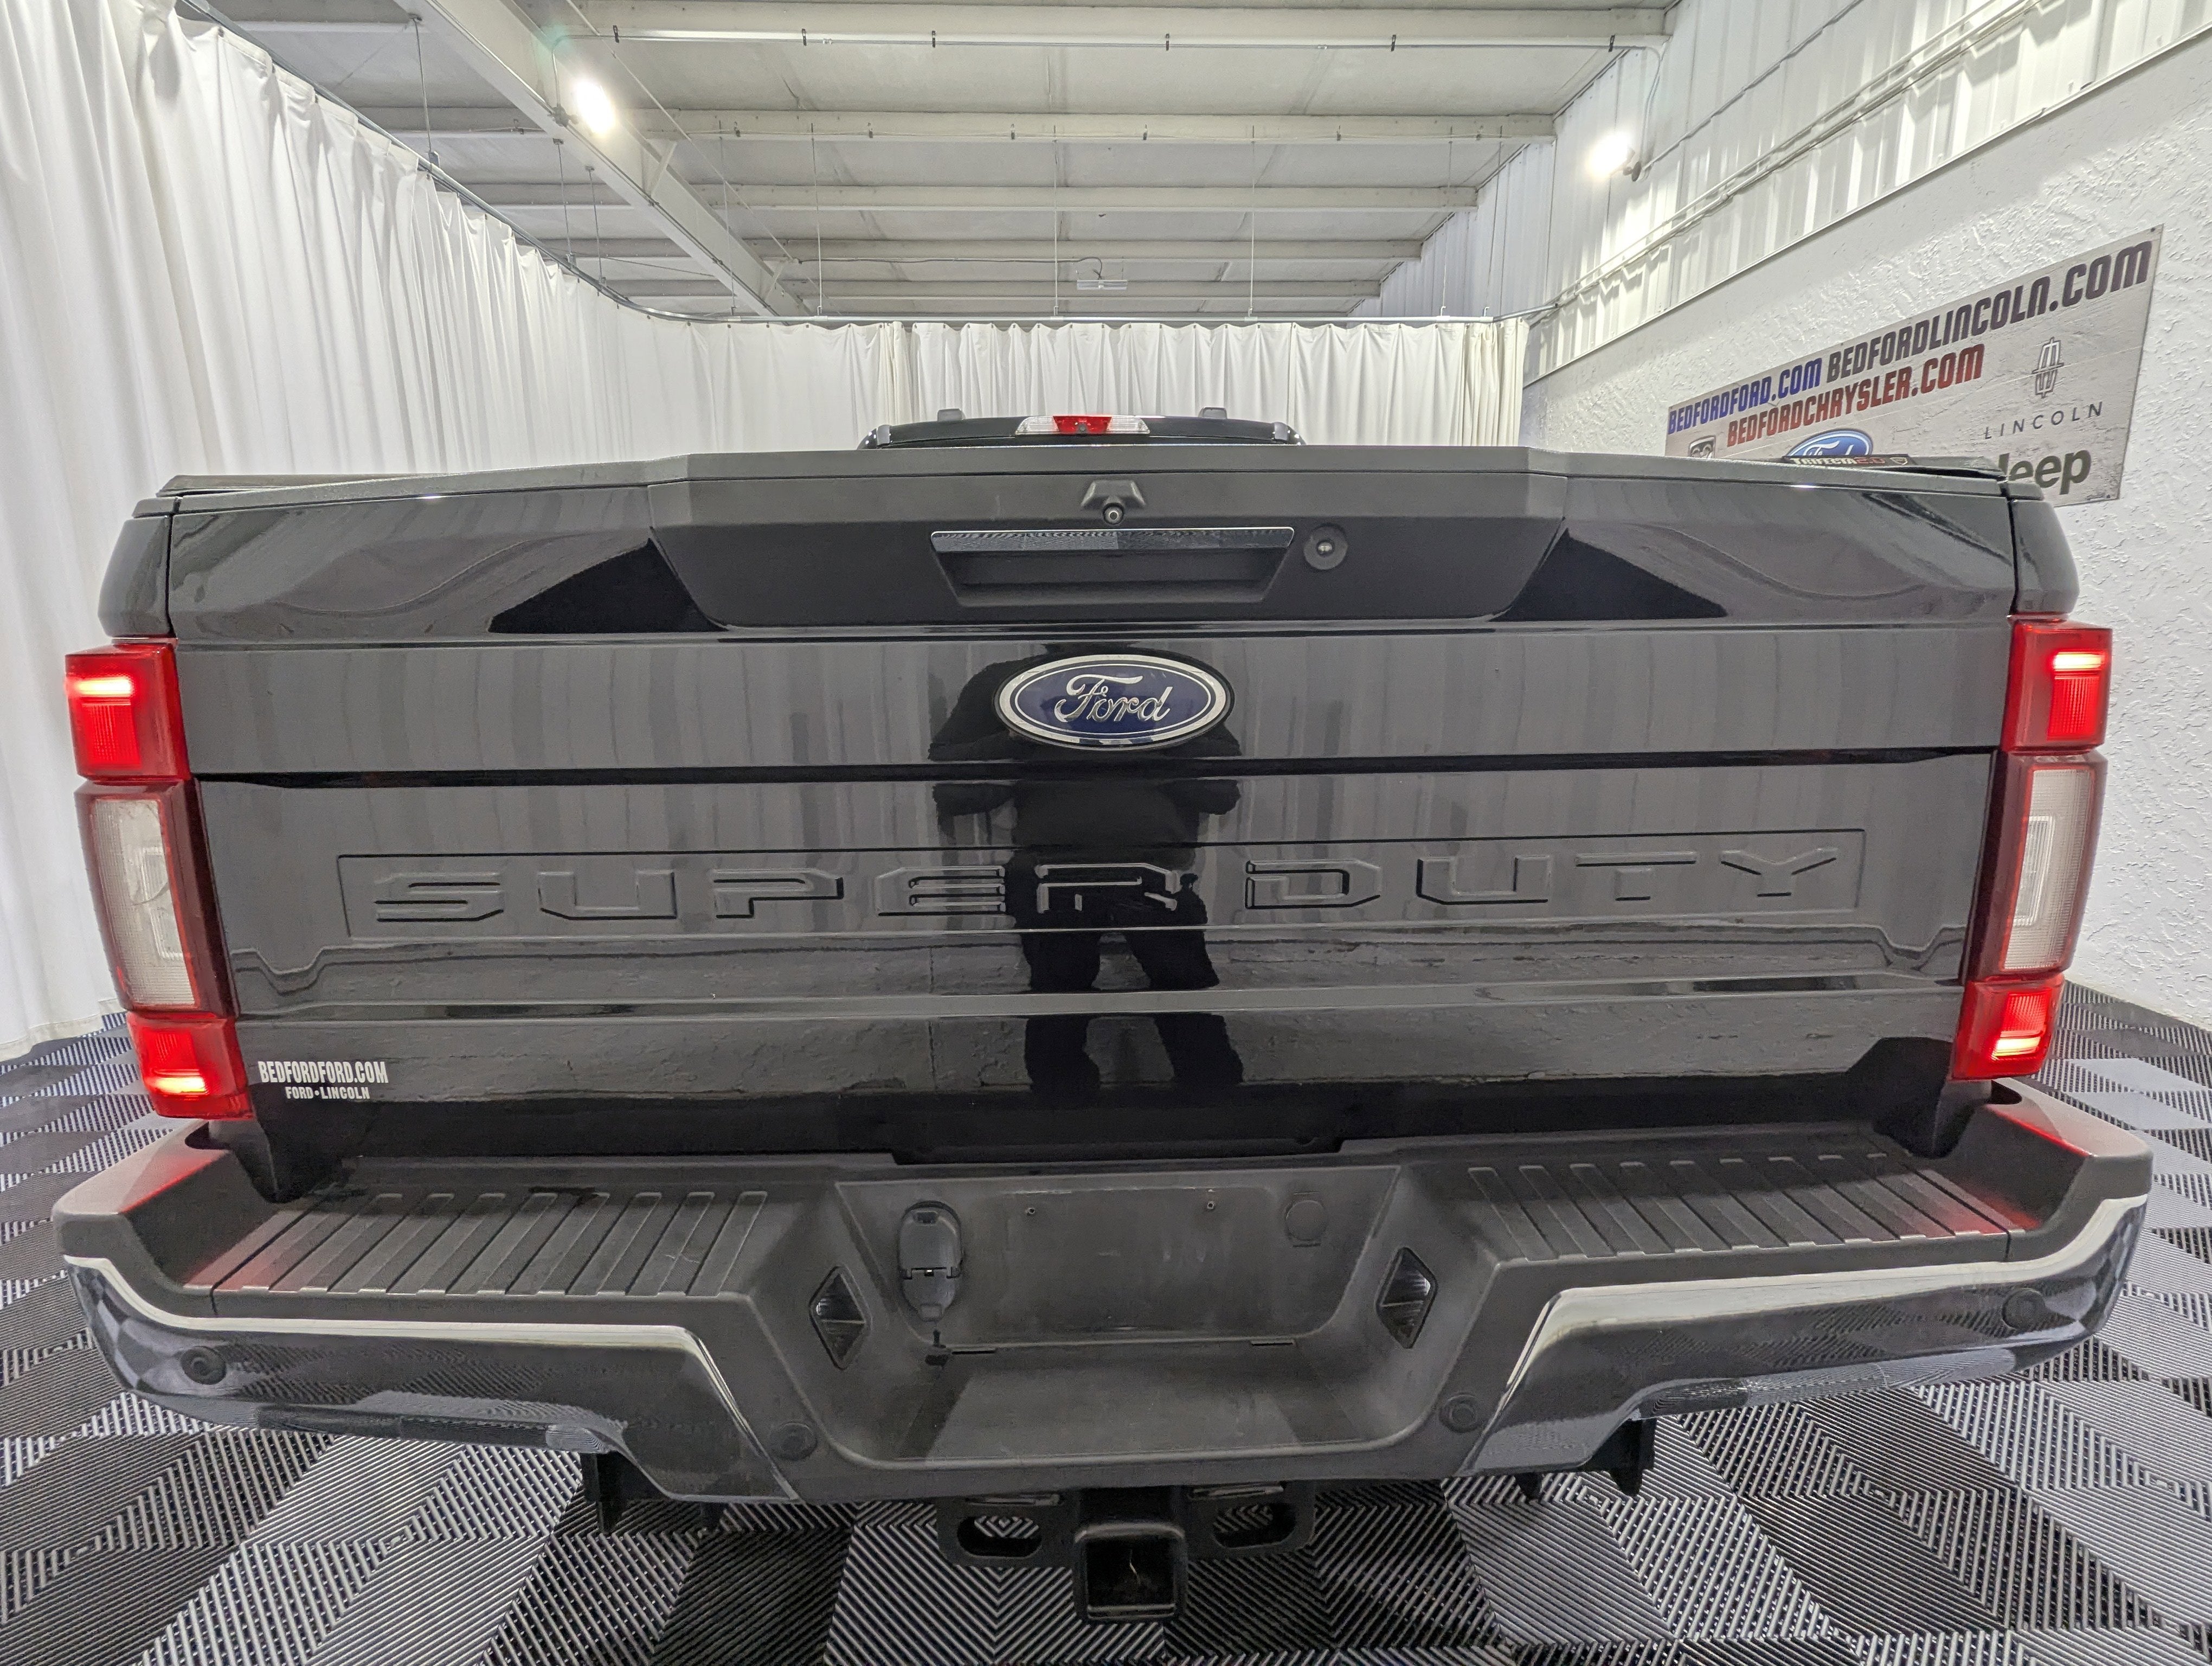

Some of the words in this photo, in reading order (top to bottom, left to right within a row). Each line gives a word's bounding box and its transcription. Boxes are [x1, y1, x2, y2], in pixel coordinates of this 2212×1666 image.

[1667, 357, 1822, 434] BEDFORDFORD.COM
[1826, 240, 2152, 383] BEDFORDLINCOLN.COM
[1726, 343, 1985, 447] BEDFORDCHRYSLER.COM
[1984, 401, 2103, 440] LINCOLN
[1054, 674, 1173, 723] Ford
[374, 862, 1181, 922] SUPER
[1244, 846, 1840, 909] DUTY
[258, 1060, 389, 1084] BEDFORDFORD.COM
